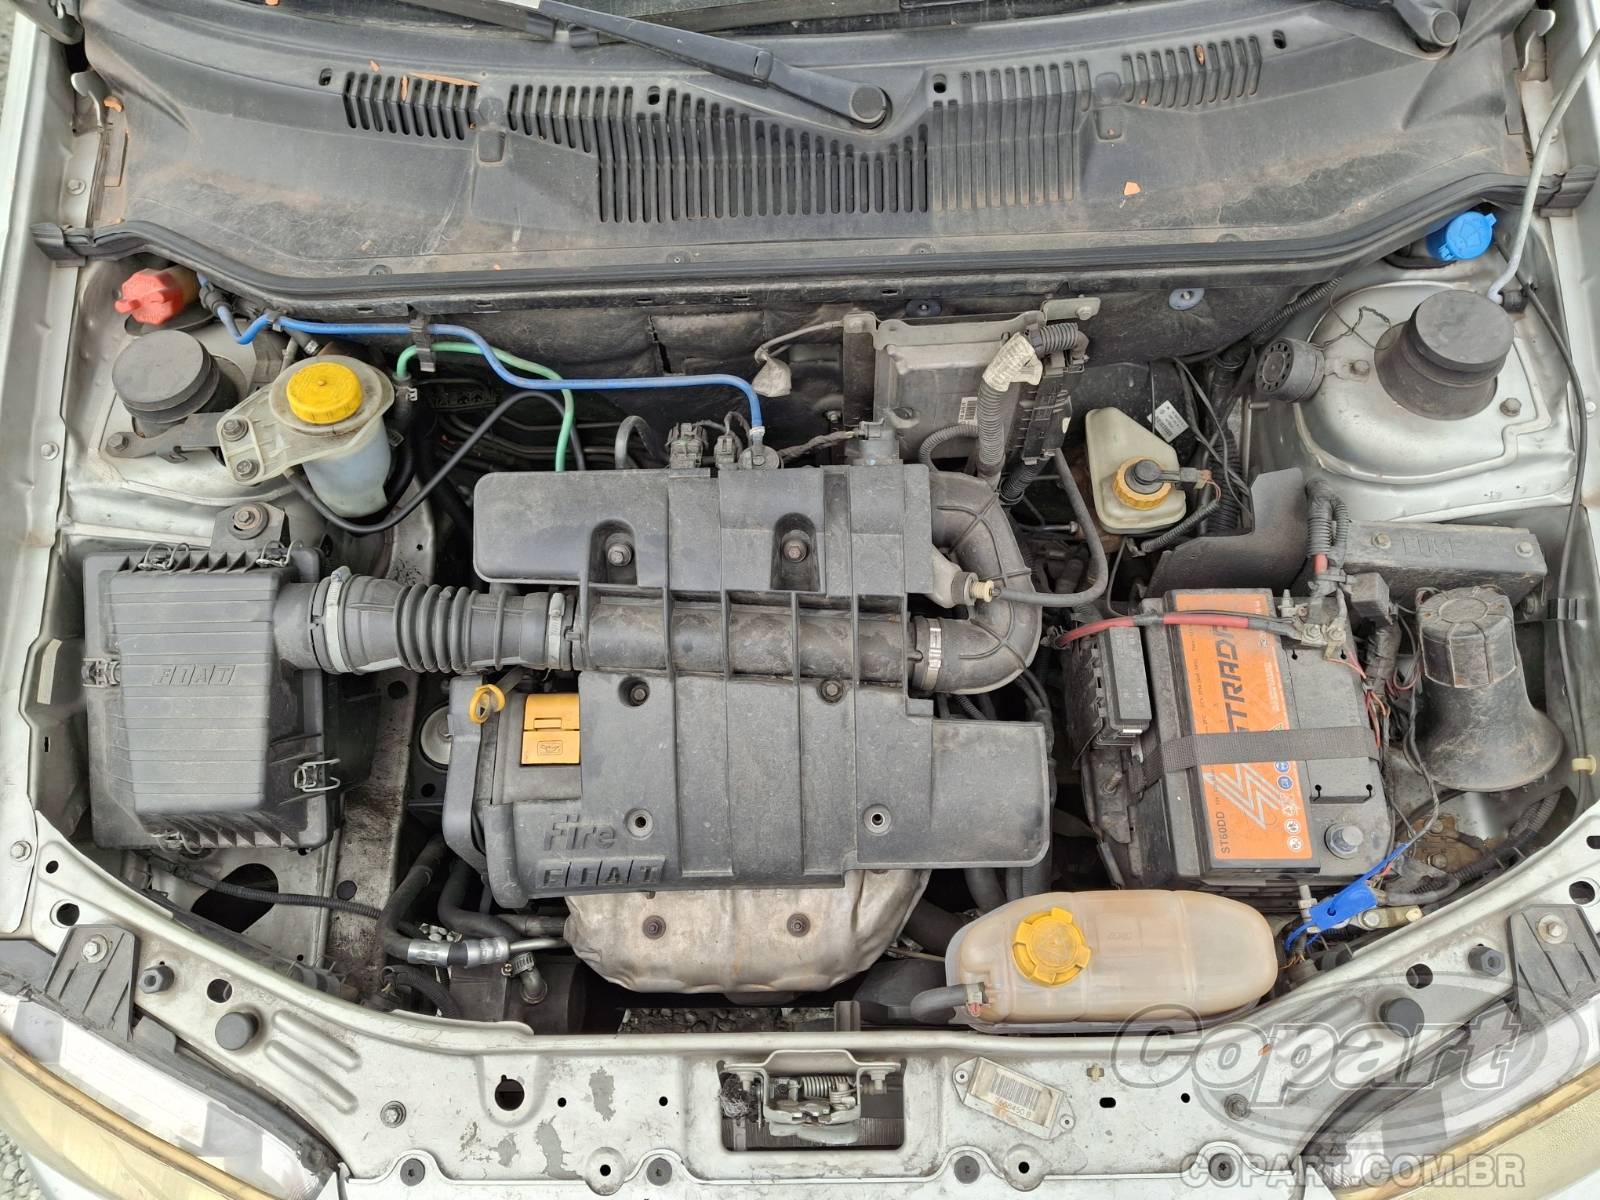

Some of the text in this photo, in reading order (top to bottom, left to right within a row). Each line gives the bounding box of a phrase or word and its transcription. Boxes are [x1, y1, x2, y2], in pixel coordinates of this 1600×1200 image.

[154, 665, 235, 685] FIAT
[544, 814, 617, 851] Fire
[1215, 812, 1231, 854] ST60DD
[540, 862, 661, 887] FIAT
